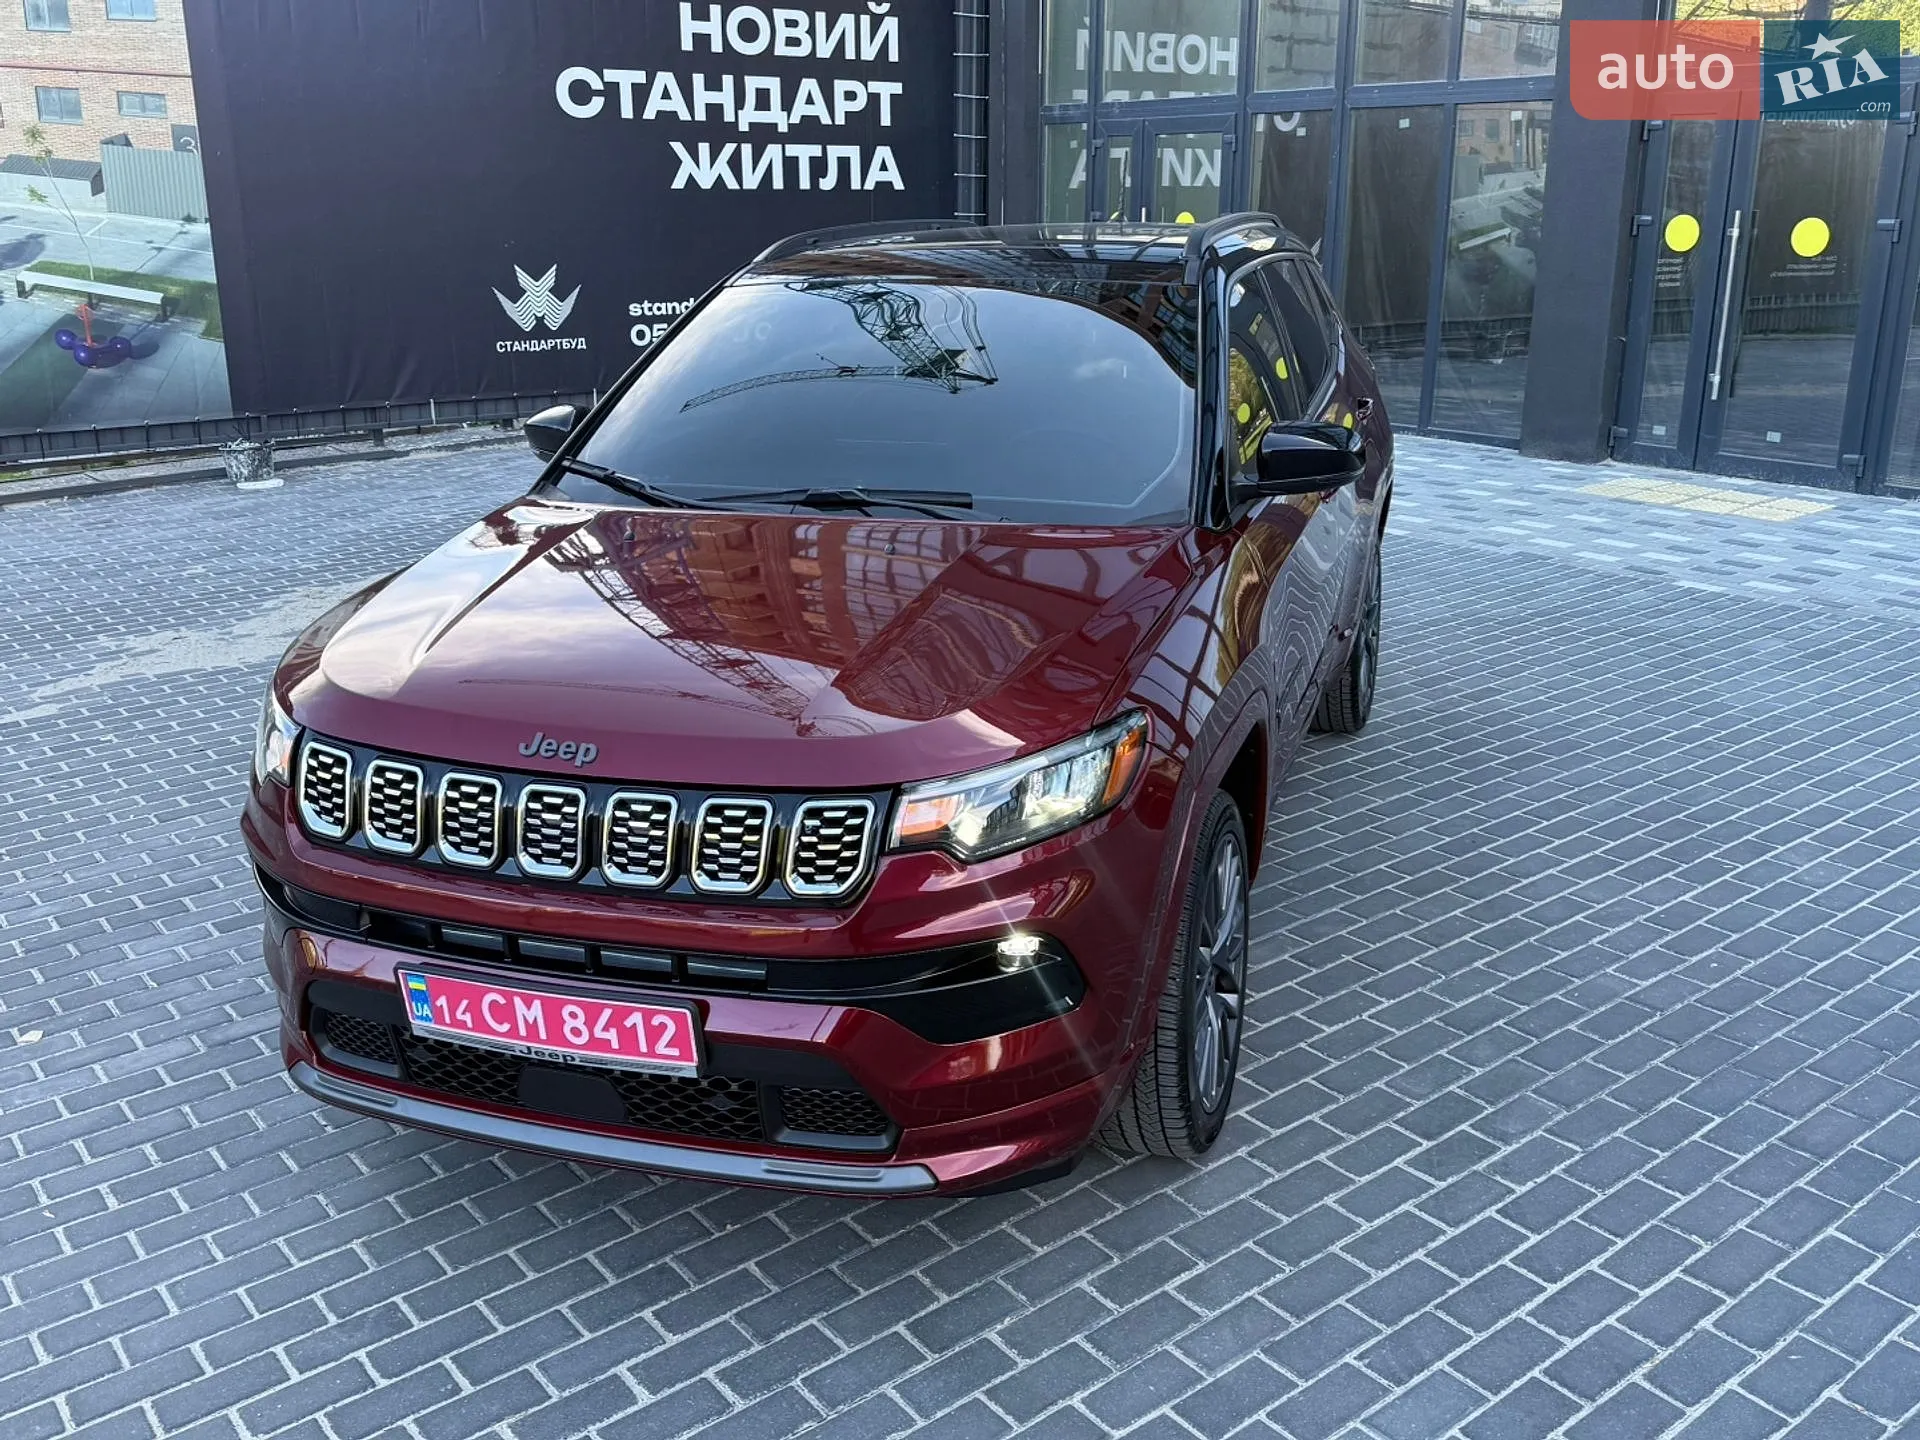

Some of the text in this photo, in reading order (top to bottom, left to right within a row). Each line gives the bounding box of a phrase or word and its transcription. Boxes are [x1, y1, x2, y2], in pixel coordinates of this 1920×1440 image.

[679, 1, 900, 63] НОВИЙ
[555, 66, 903, 133] СТАНДАРТ
[669, 142, 905, 191] ЖИТЛА
[496, 337, 587, 353] СТАНДАРТБУД
[518, 731, 599, 768] Jeep
[412, 1001, 433, 1018] UA
[434, 992, 681, 1057] 14 CM 8412
[518, 1046, 576, 1063] Jeep
